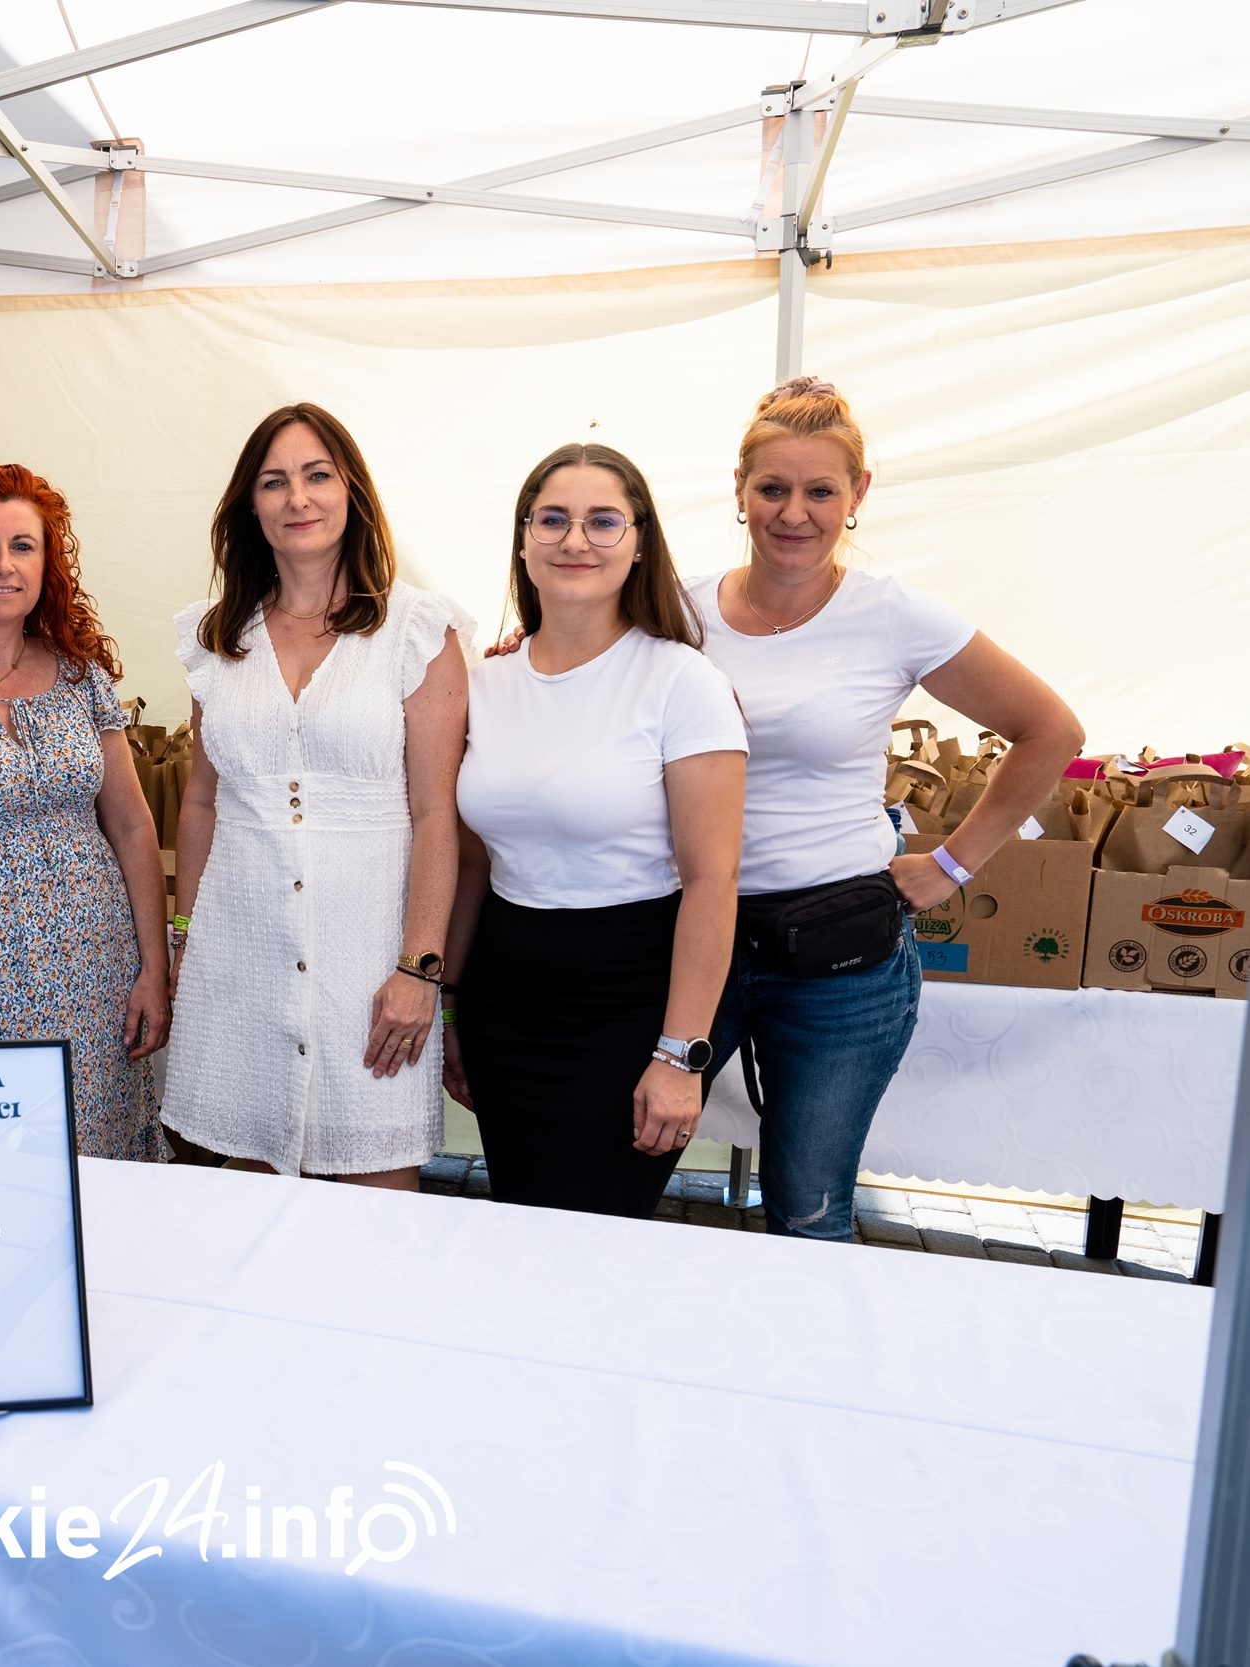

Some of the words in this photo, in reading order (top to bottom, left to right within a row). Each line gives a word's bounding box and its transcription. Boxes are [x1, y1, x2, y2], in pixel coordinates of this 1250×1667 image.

[1183, 824, 1198, 837] 32
[1147, 905, 1235, 924] OSKROBA
[913, 919, 949, 932] UIZA
[926, 950, 948, 967] 53
